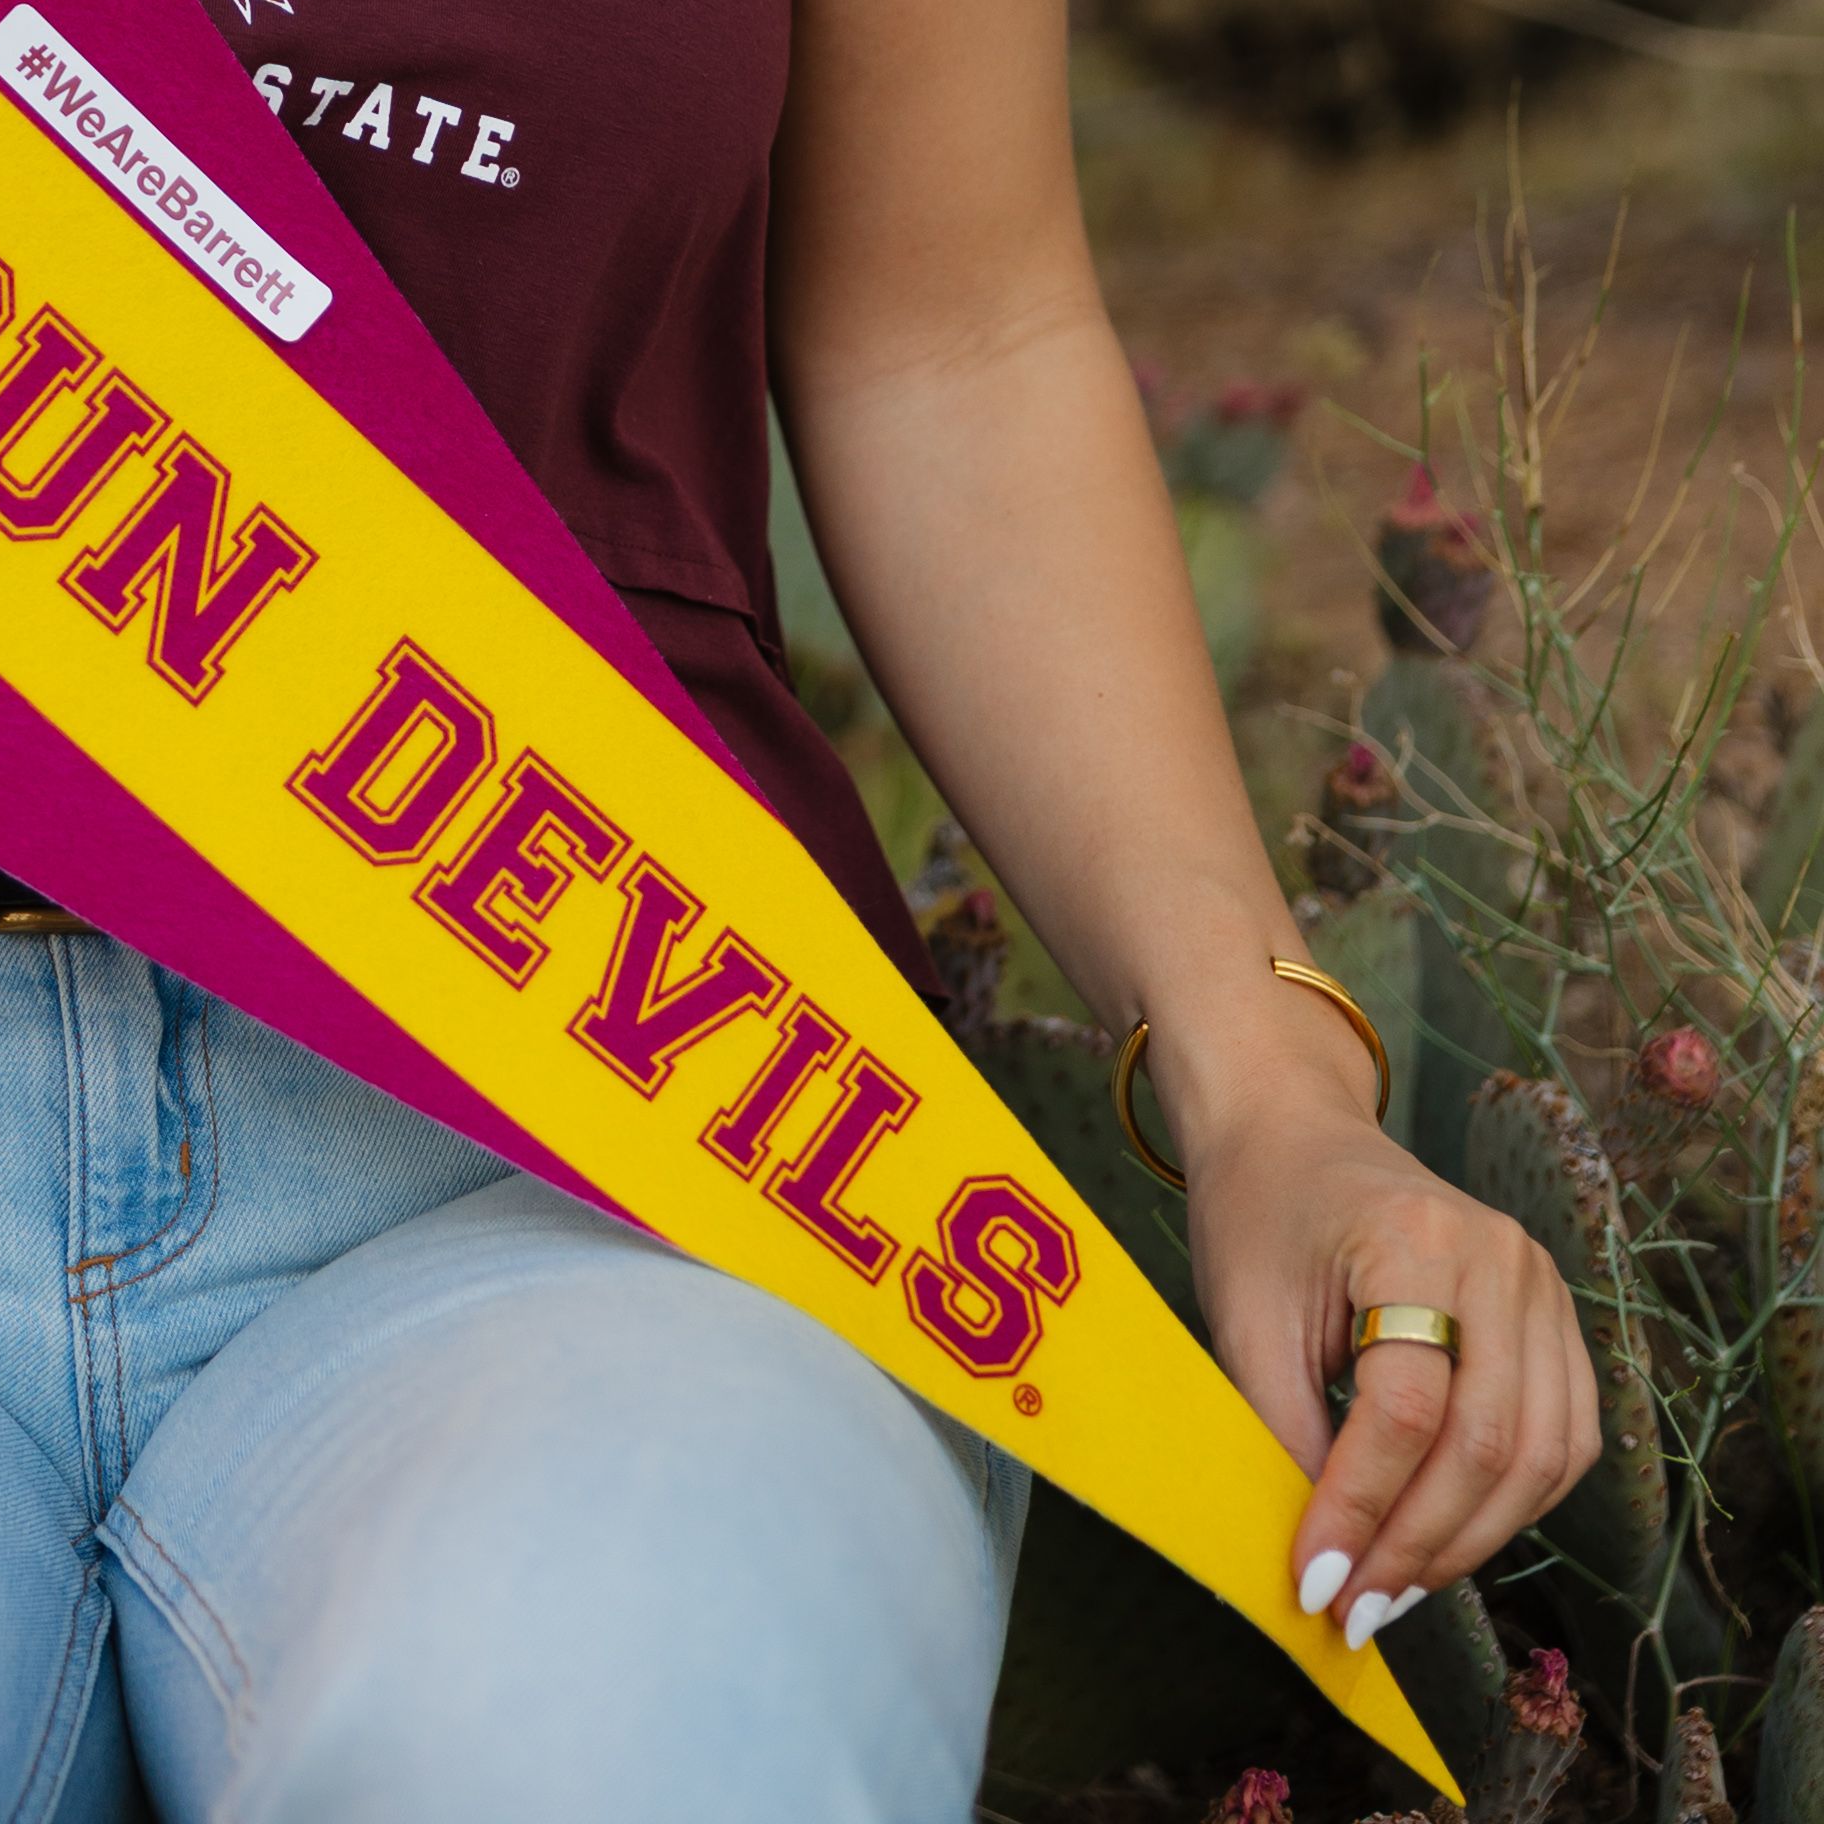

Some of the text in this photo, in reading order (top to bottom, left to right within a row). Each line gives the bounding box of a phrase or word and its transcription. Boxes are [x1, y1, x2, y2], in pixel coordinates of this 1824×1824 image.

[15, 44, 296, 315] #WeAreBarrett
[252, 63, 516, 184] STATE
[286, 635, 1082, 1379] DEVILS
